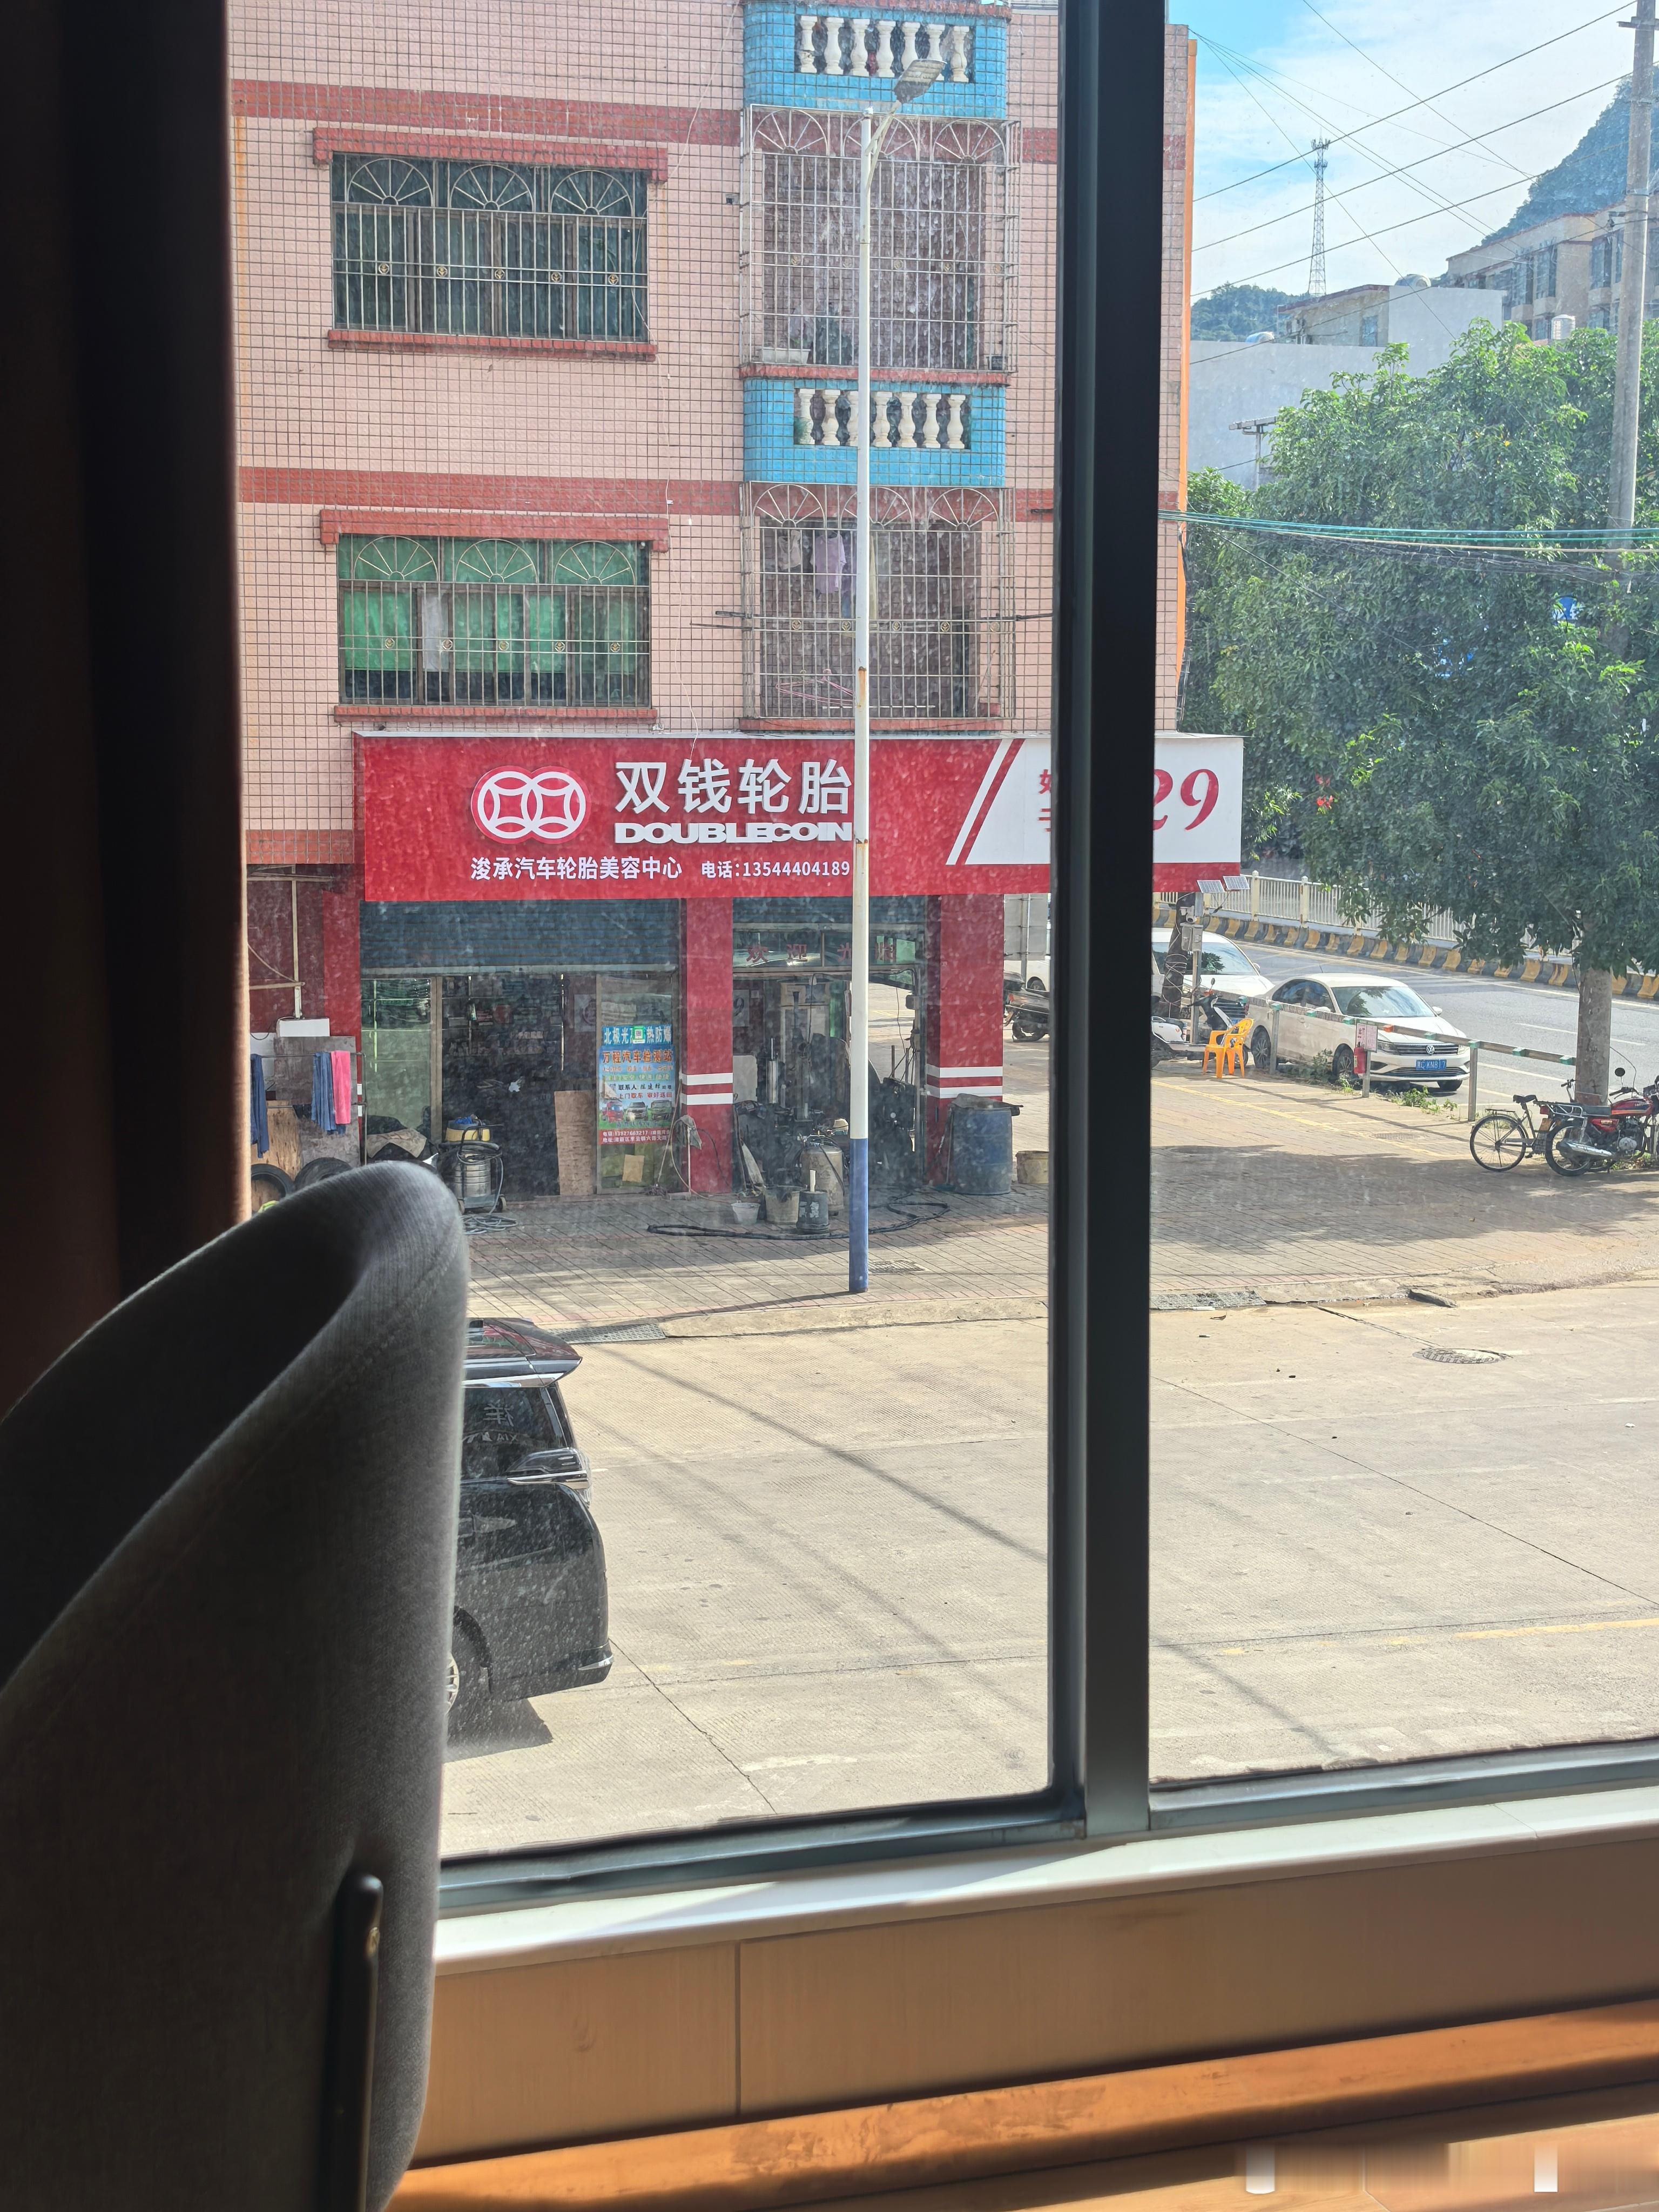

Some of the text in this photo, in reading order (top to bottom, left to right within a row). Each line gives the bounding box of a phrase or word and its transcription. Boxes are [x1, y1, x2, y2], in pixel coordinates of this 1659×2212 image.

[615, 758, 852, 814] 双钱轮胎
[615, 822, 852, 844] DOUBLECOIN
[470, 855, 850, 880] 浚承汽车轮胎美容中心 电话:13544404189
[604, 1026, 672, 1044] 北极光热防爆
